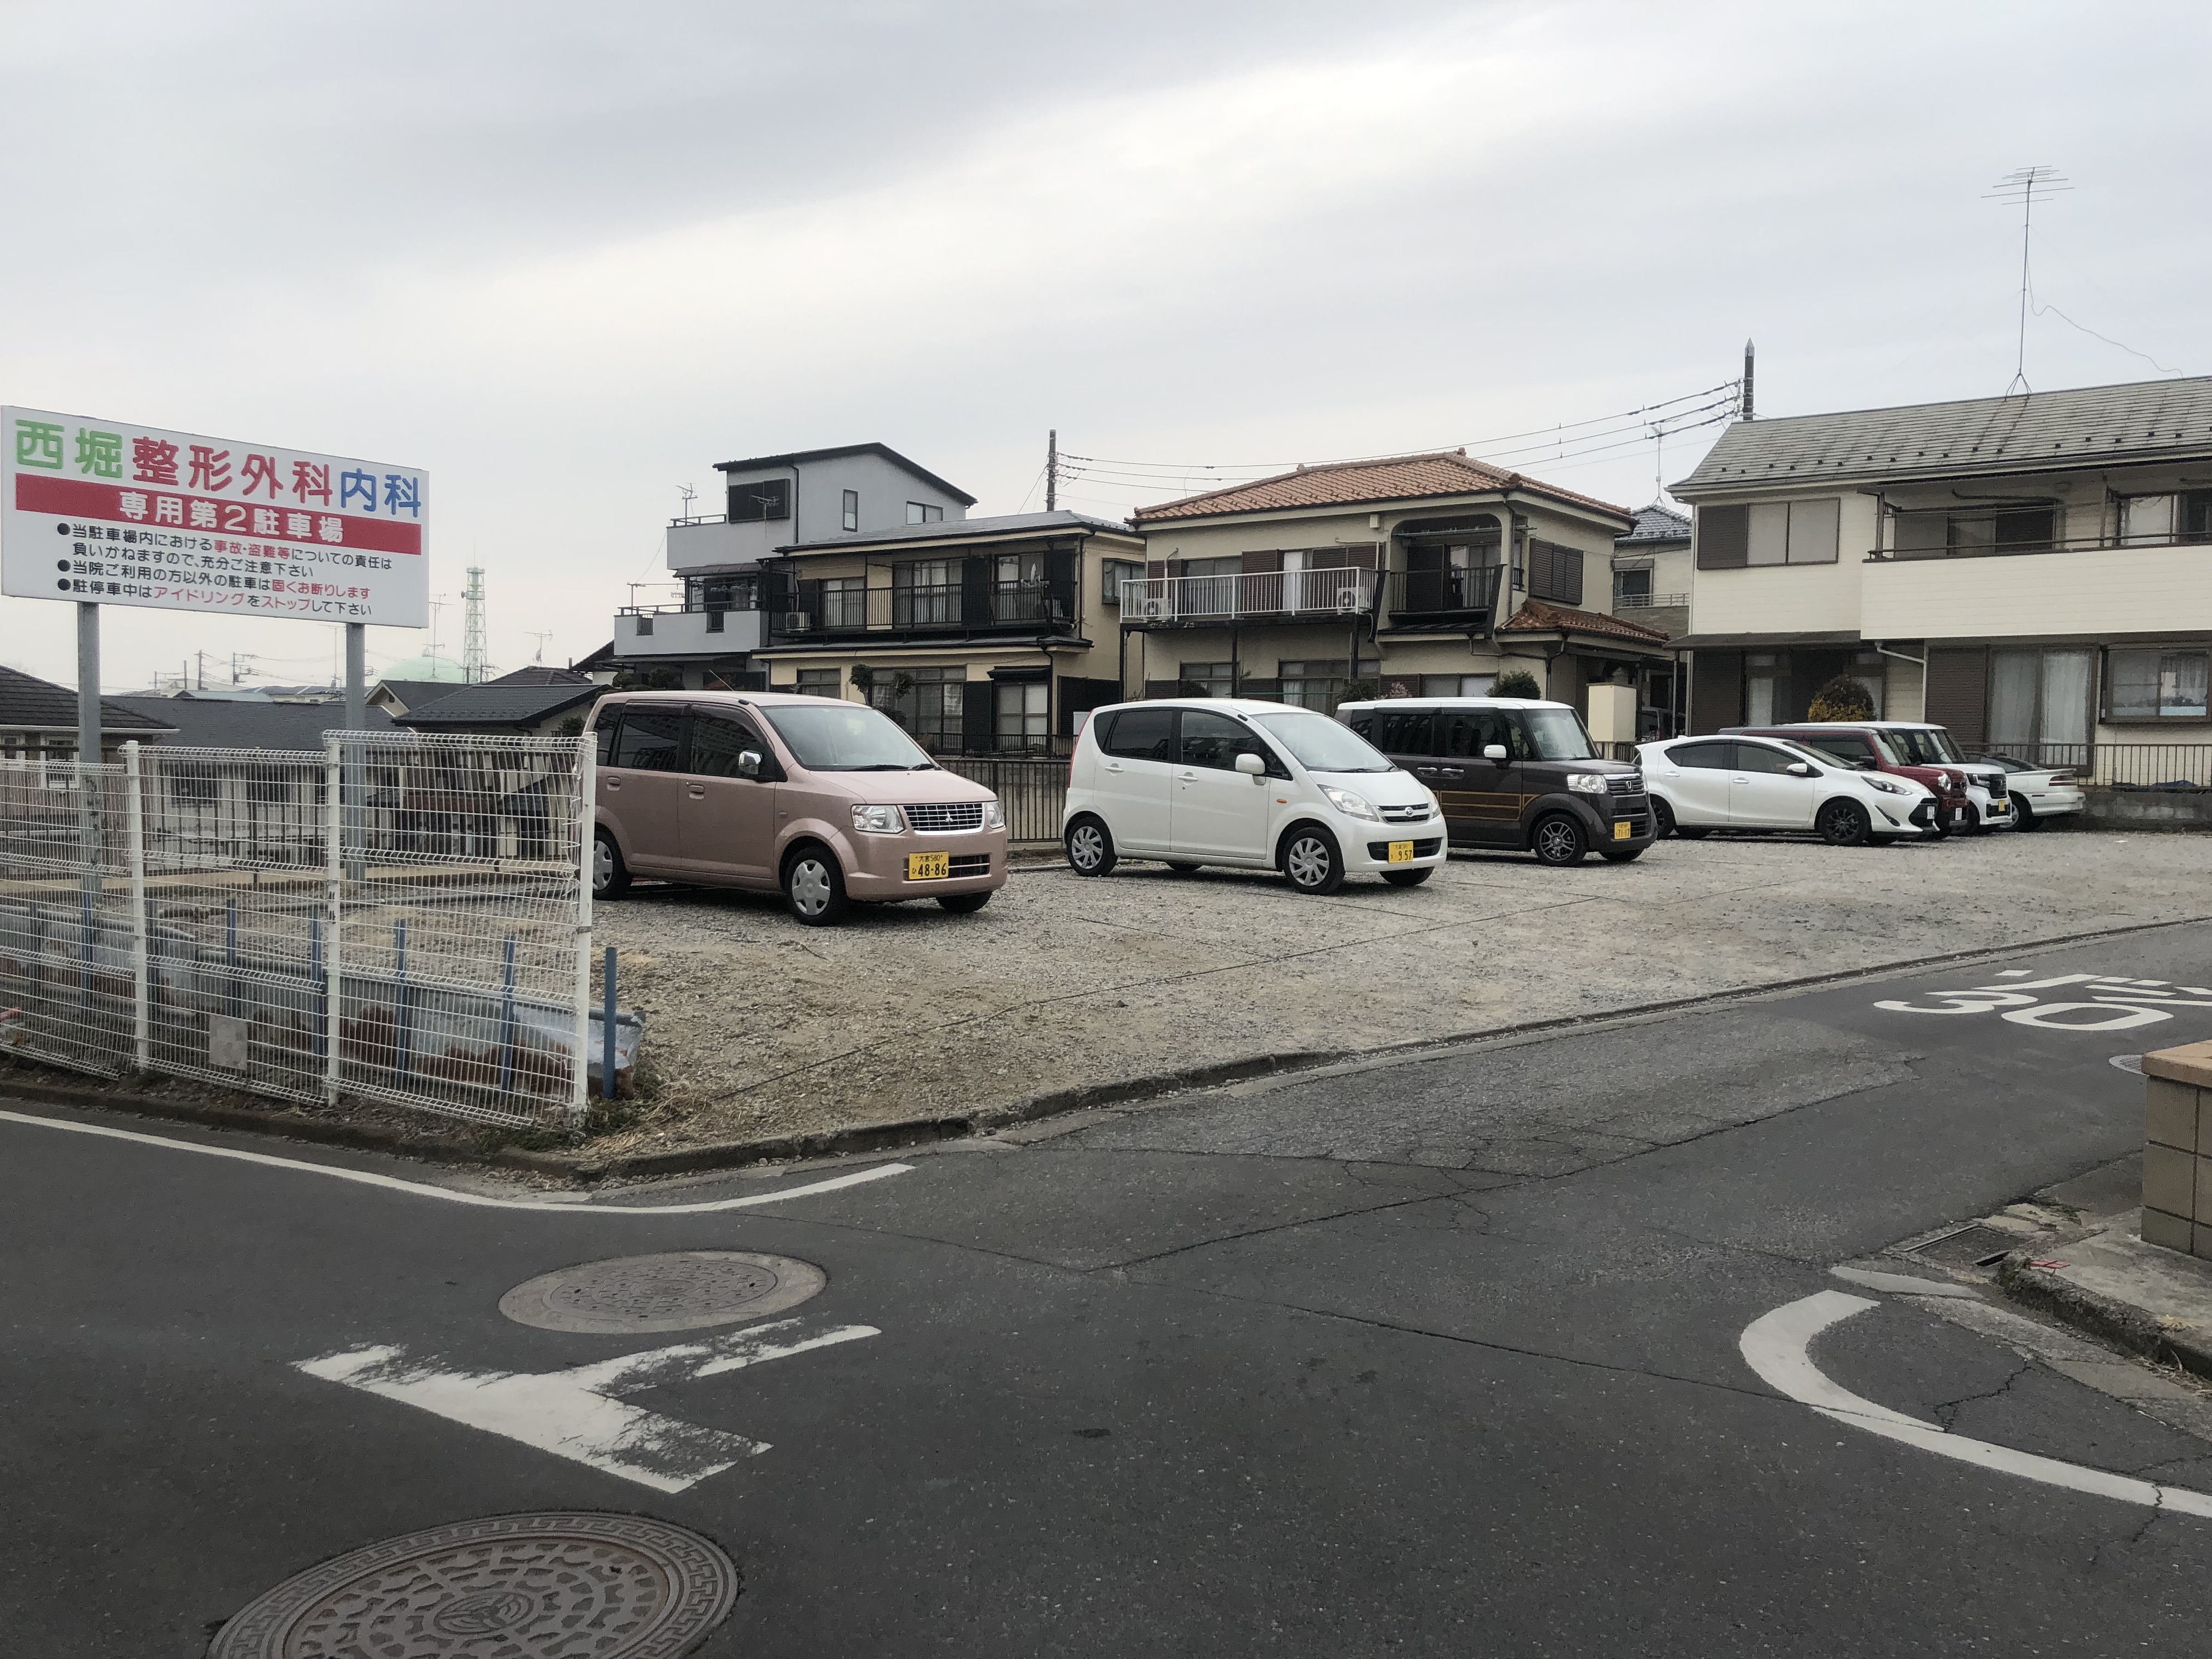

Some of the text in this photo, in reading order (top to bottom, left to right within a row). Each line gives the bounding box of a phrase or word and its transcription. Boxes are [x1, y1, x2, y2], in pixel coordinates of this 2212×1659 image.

[15, 419, 422, 518] 西堀整形外科内科
[119, 491, 344, 543] 専用第2駐車場
[72, 560, 371, 600] 当院ご利用の方以外の駐車は固くお断りします
[72, 578, 372, 616] 駐停車中はアイドリングをストップして下さい
[918, 863, 947, 877] 48-86
[1873, 980, 2175, 1031] 30
